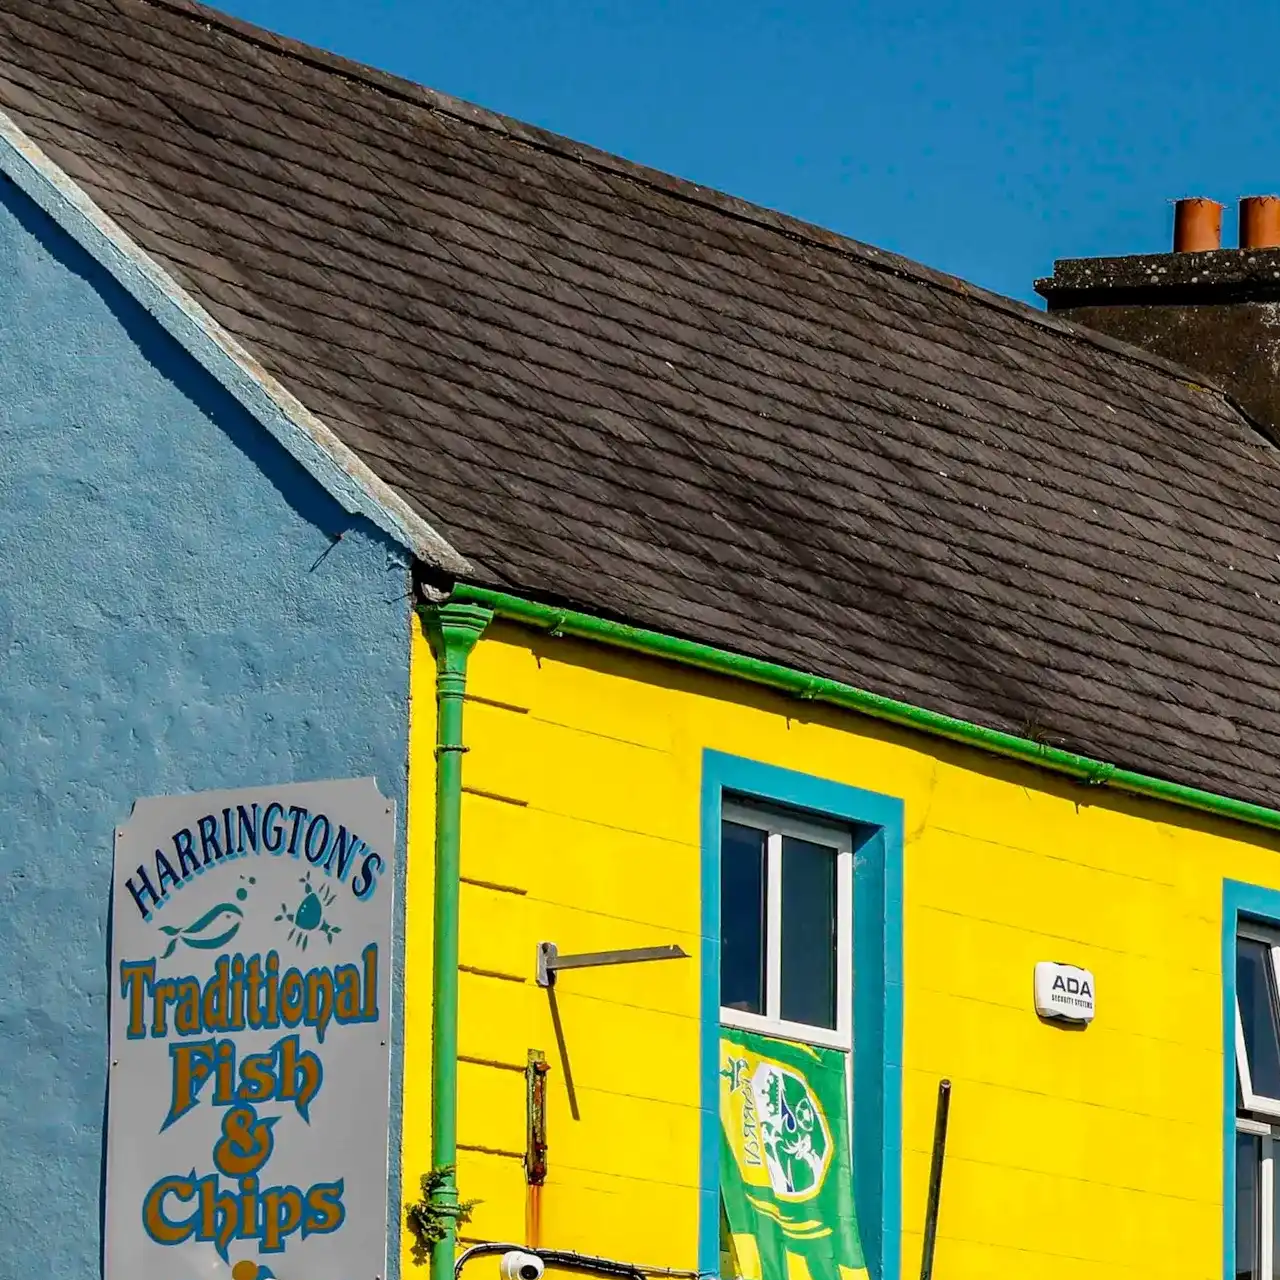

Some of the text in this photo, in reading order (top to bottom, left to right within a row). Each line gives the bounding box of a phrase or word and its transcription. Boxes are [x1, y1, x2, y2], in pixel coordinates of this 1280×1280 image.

[126, 802, 385, 924] HARRINGTON'S
[121, 943, 379, 1044] Traditional
[1052, 975, 1092, 998] ADA
[159, 1034, 322, 1133] Fish
[214, 1102, 281, 1178] &
[142, 1167, 345, 1264] Chips
